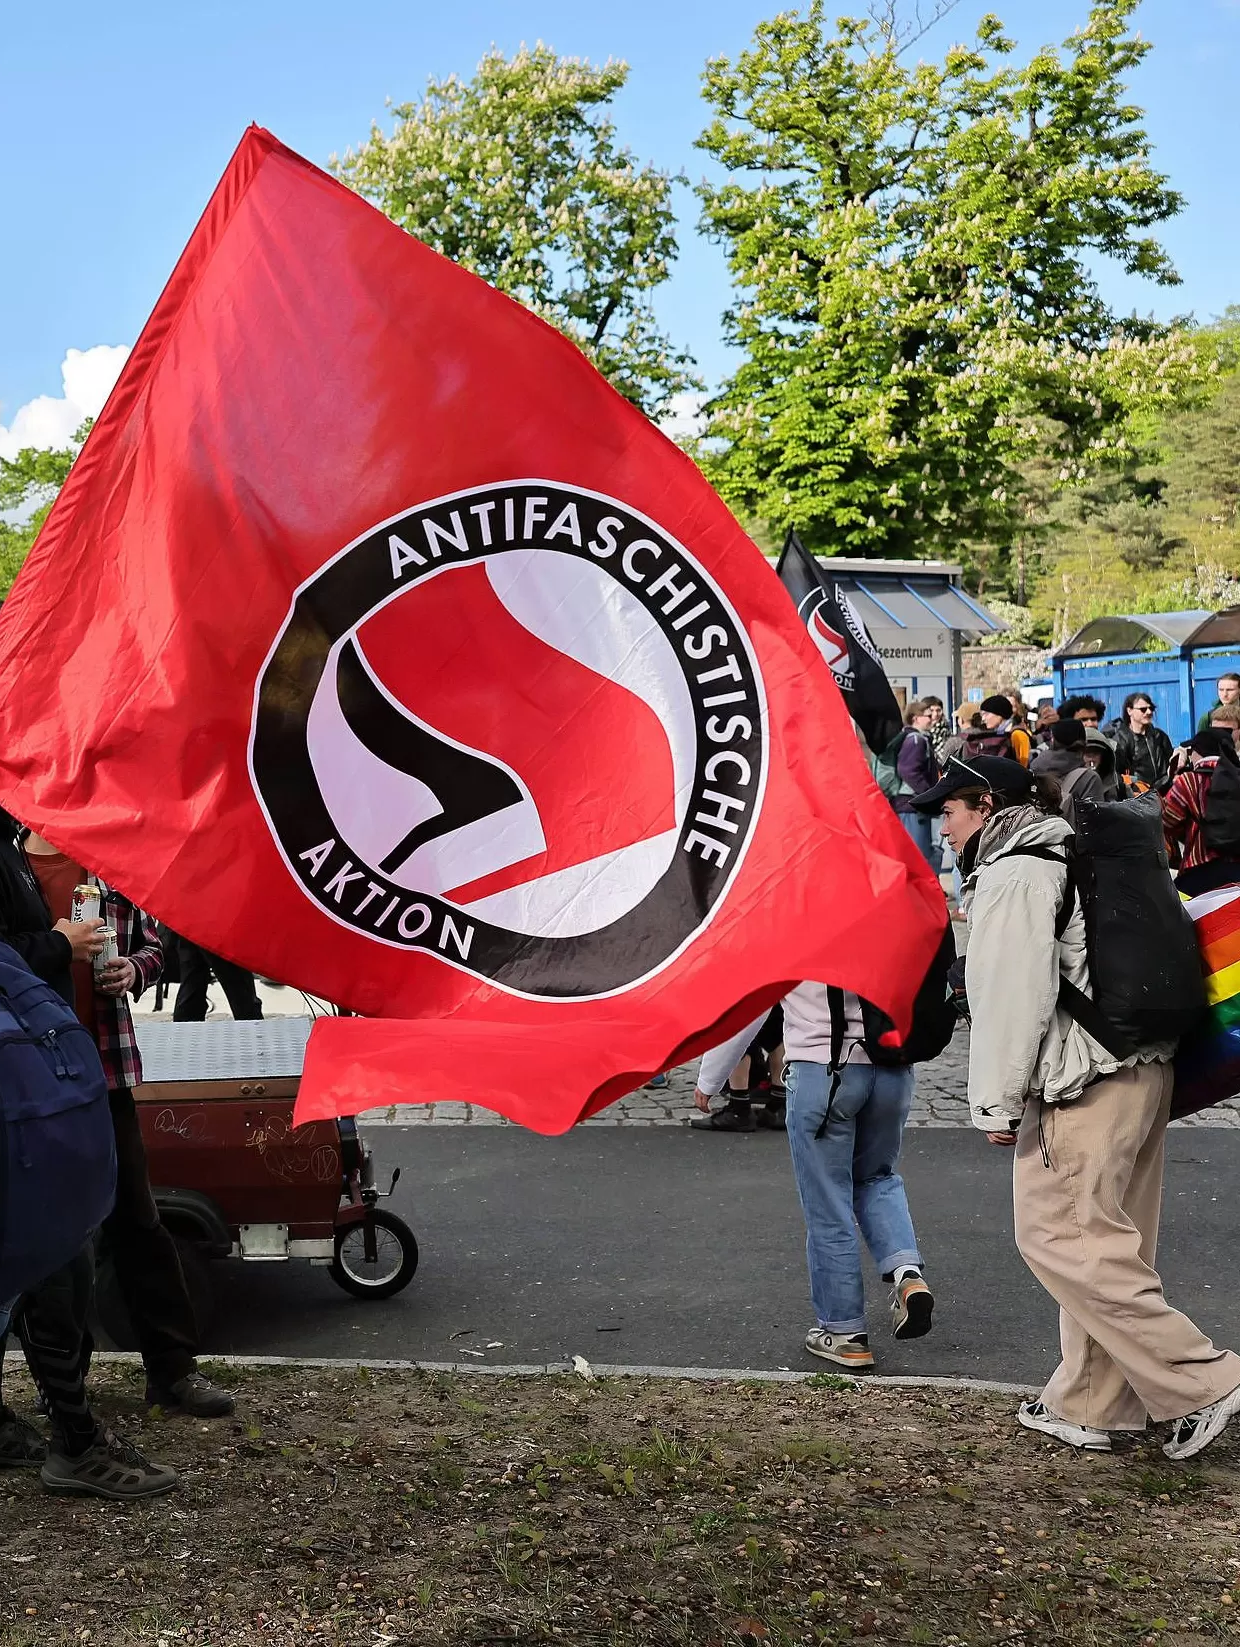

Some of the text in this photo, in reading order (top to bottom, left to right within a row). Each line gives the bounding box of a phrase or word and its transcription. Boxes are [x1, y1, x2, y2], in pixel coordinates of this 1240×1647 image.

[388, 496, 752, 870] ANTIFASCHISTISCHE
[875, 645, 933, 659] sezentrum
[298, 838, 475, 961] AKTION
